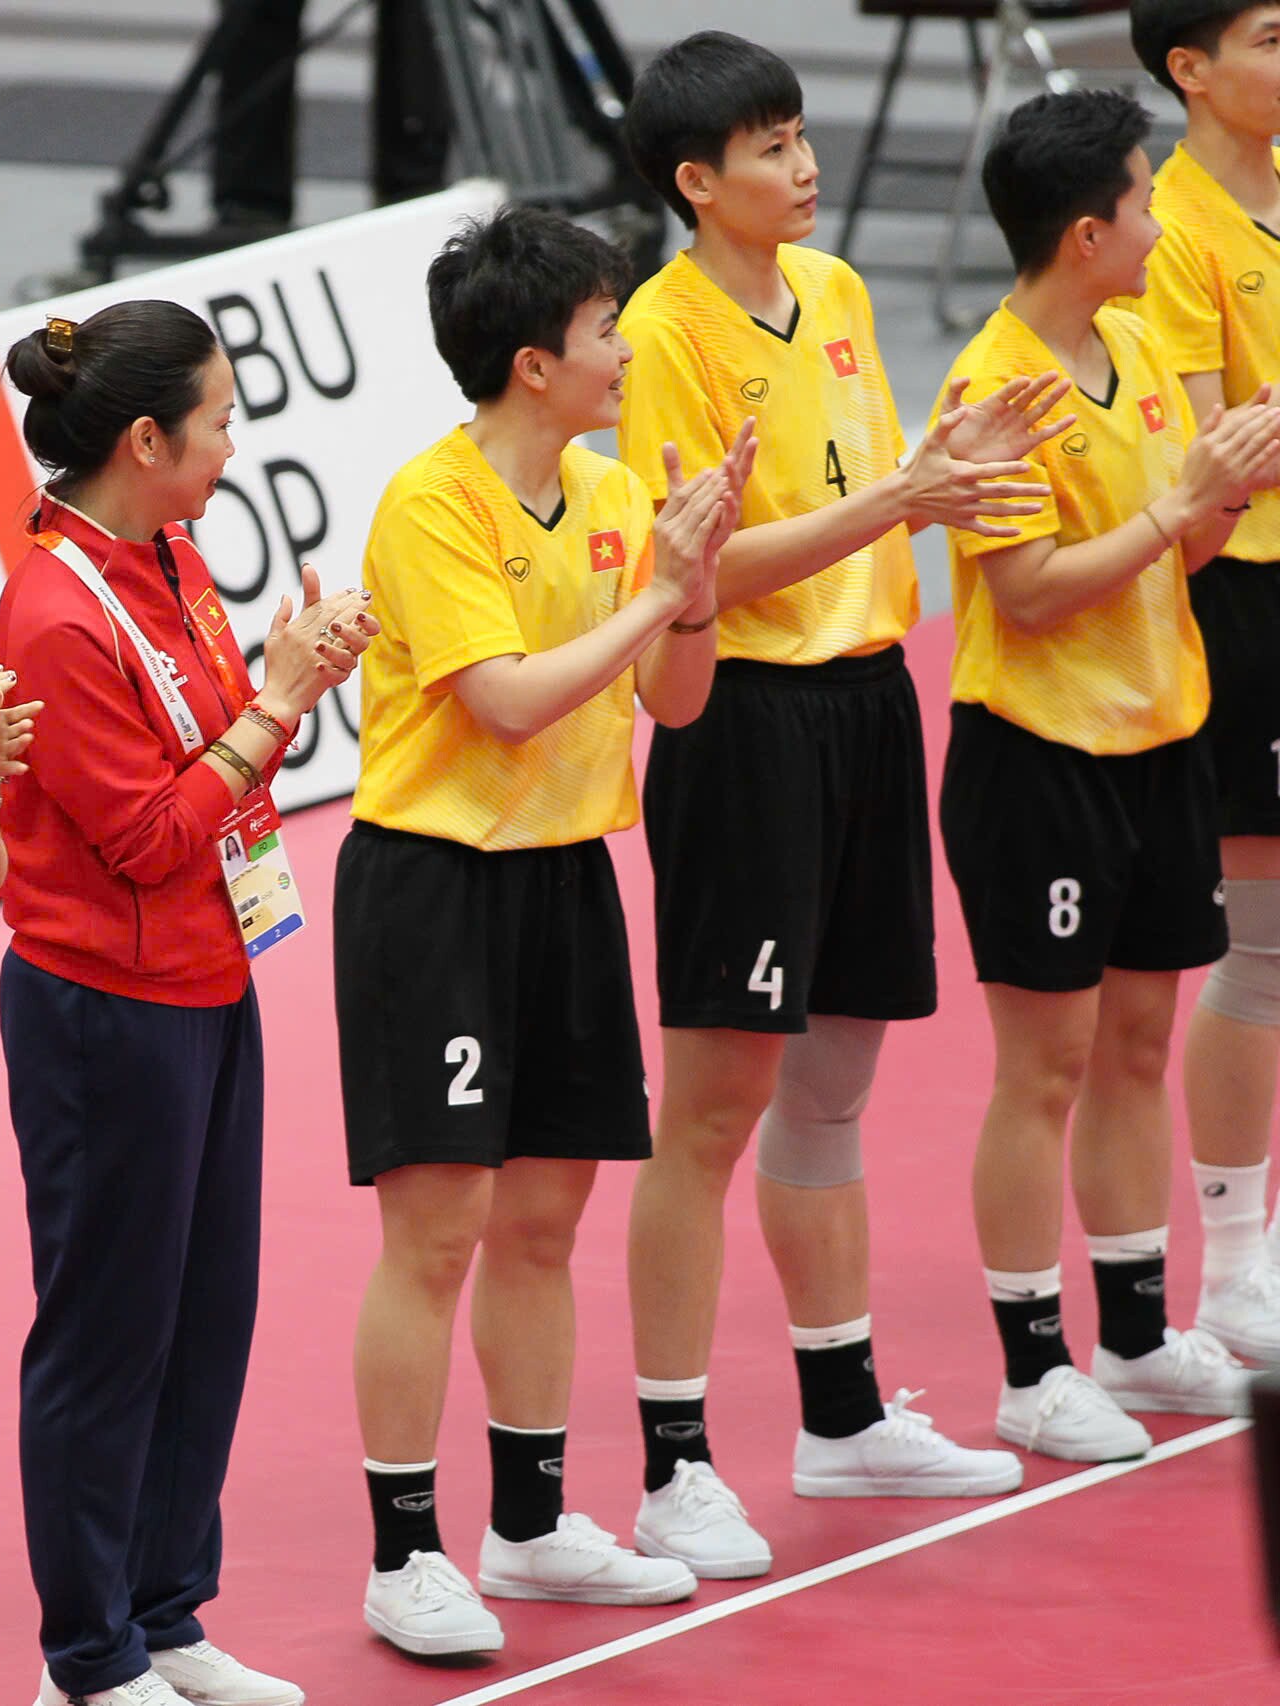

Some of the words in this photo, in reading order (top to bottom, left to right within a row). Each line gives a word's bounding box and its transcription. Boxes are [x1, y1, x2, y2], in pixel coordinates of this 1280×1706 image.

[826, 439, 847, 498] 4
[1047, 877, 1082, 938] 8
[747, 939, 783, 1011] 4
[444, 1035, 484, 1106] 2
